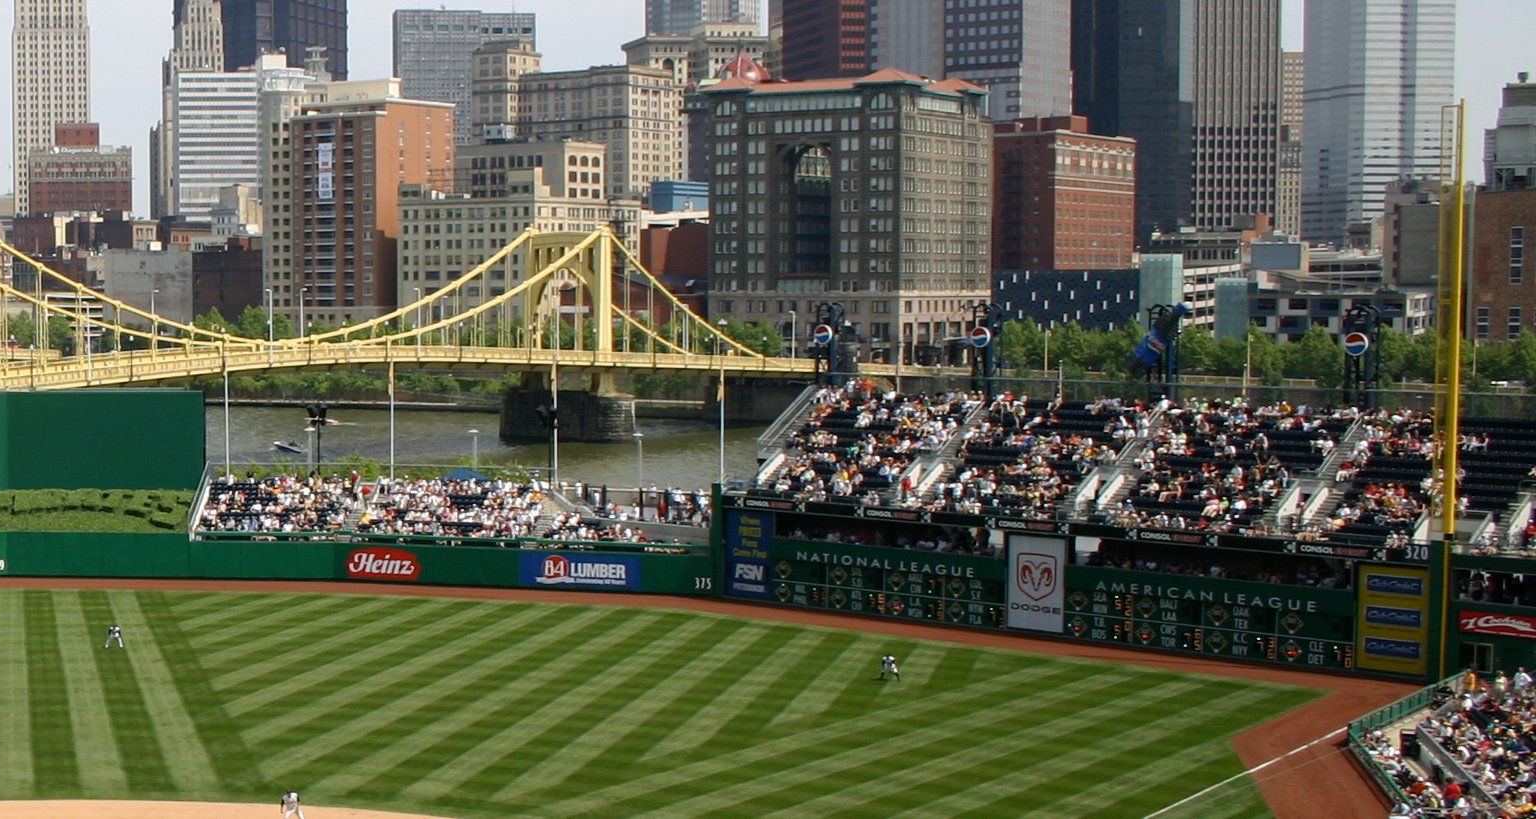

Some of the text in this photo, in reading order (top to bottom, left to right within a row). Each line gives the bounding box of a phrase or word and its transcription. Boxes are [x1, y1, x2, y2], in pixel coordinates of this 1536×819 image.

[998, 520, 1026, 529] CONSOL
[1140, 532, 1171, 541] CONSOL
[1300, 544, 1334, 554] CONSOL
[1405, 546, 1428, 560] 320
[348, 553, 415, 575] Heinz
[544, 560, 626, 578] 84 LUMBER
[796, 551, 976, 578] NATIONAL LEAGUE
[735, 563, 764, 580] FSN
[694, 577, 712, 590] 375
[1096, 581, 1317, 612] AMERICAN LEAGUE
[1010, 602, 1062, 616] DODGE
